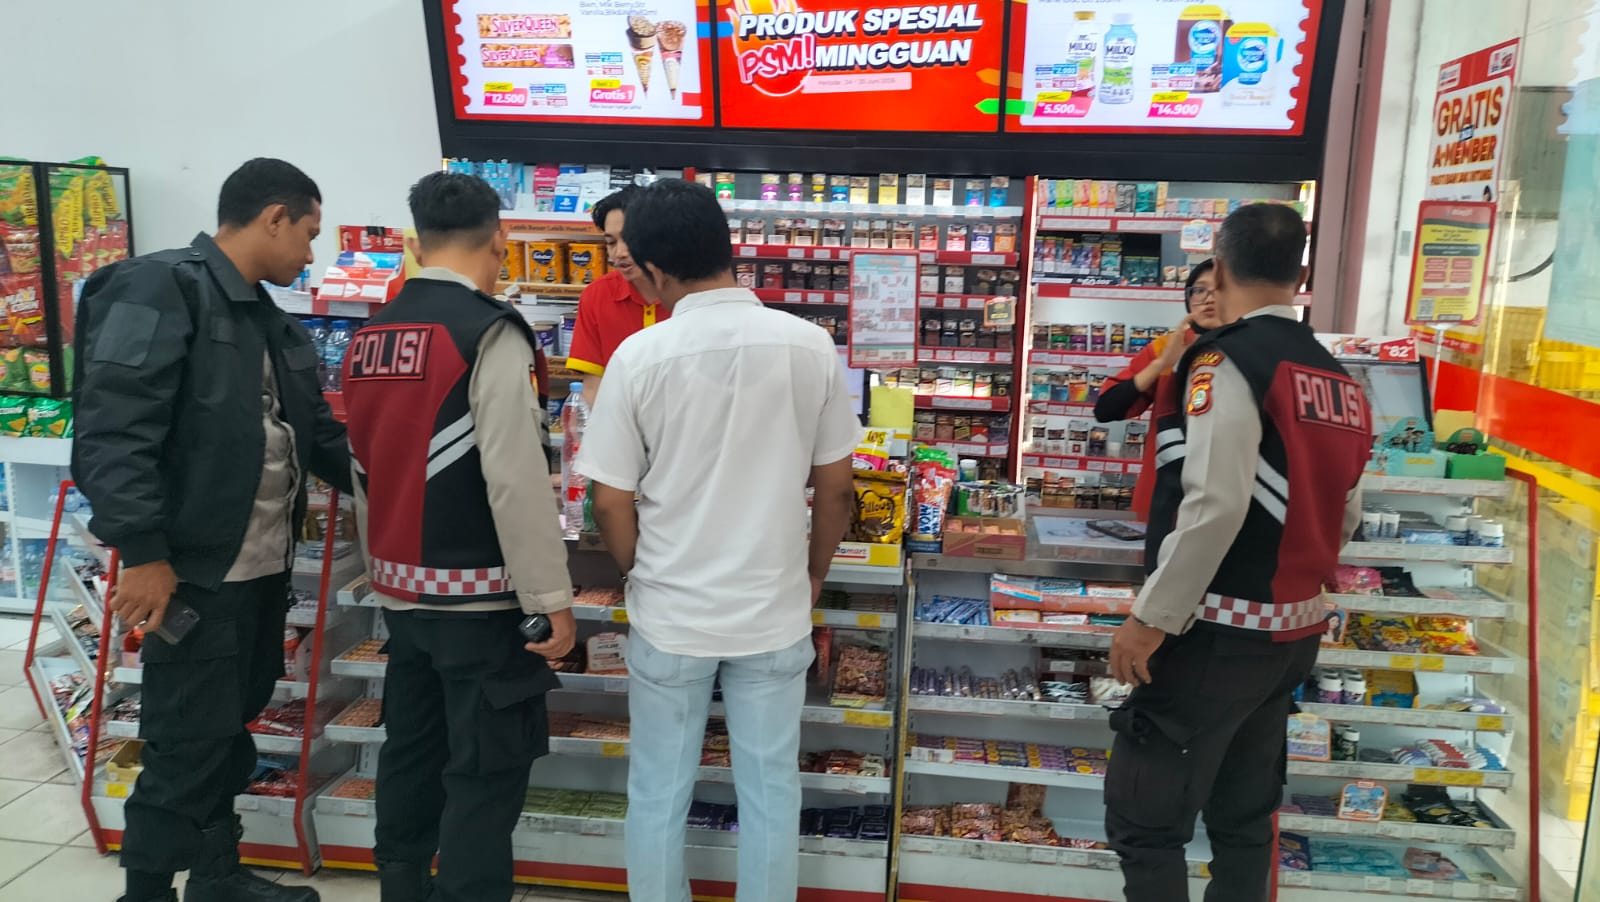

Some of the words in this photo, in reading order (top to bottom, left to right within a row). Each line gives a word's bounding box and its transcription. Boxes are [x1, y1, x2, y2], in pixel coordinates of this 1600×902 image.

[491, 16, 558, 33] SILVERQUEEN
[738, 10, 856, 39] PRODUK
[862, 4, 983, 33] SPESIAL
[481, 47, 538, 62] SILVERQUEEN
[737, 34, 815, 84] PSM!
[815, 40, 973, 69] MINGGUAN
[592, 89, 625, 101] Gratis
[627, 90, 633, 100] 1
[1437, 86, 1503, 136] GRATIS
[1433, 135, 1497, 168] A-MEMBER
[350, 331, 427, 377] POLISI
[1389, 345, 1409, 357] 82
[1294, 372, 1366, 429] POLISI
[860, 500, 891, 513] Pillows
